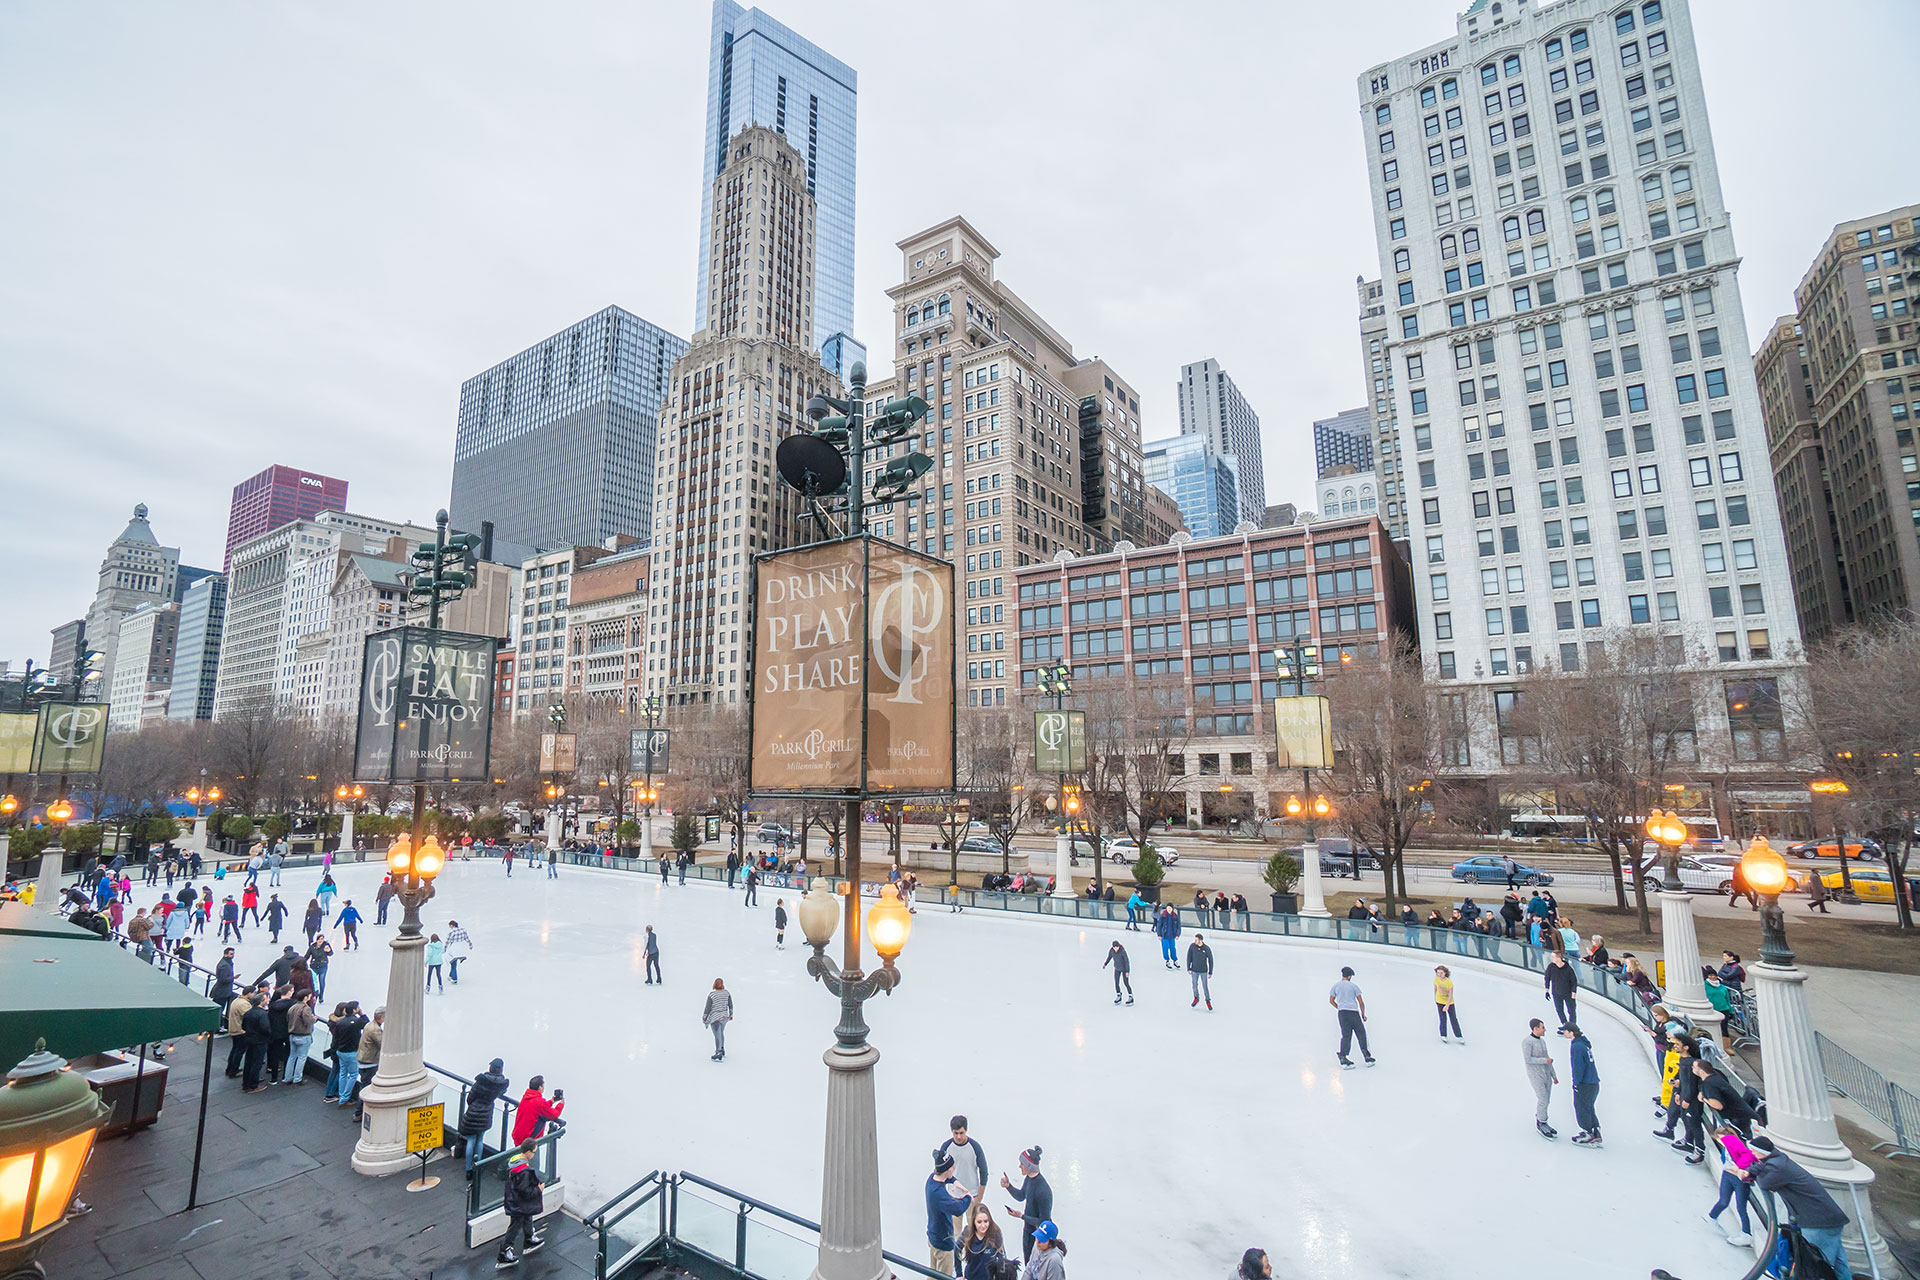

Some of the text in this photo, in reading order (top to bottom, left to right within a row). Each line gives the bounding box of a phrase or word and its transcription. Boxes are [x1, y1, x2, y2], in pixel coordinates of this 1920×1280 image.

[301, 477, 323, 488] CNA
[766, 563, 856, 605] DRINK
[766, 602, 858, 653] PLAY
[411, 644, 488, 670] SMILE
[764, 654, 860, 694] SHARE
[408, 668, 486, 702] EAT
[407, 702, 484, 726] ENJOY
[1280, 716, 1319, 727] DINE
[1281, 729, 1320, 738] LAUGH
[633, 740, 647, 749] EAT
[771, 742, 804, 754] PARK
[822, 739, 853, 753] GRILL
[410, 750, 434, 758] PARK
[449, 751, 474, 759] GRILL
[786, 760, 841, 770] Millennium Park
